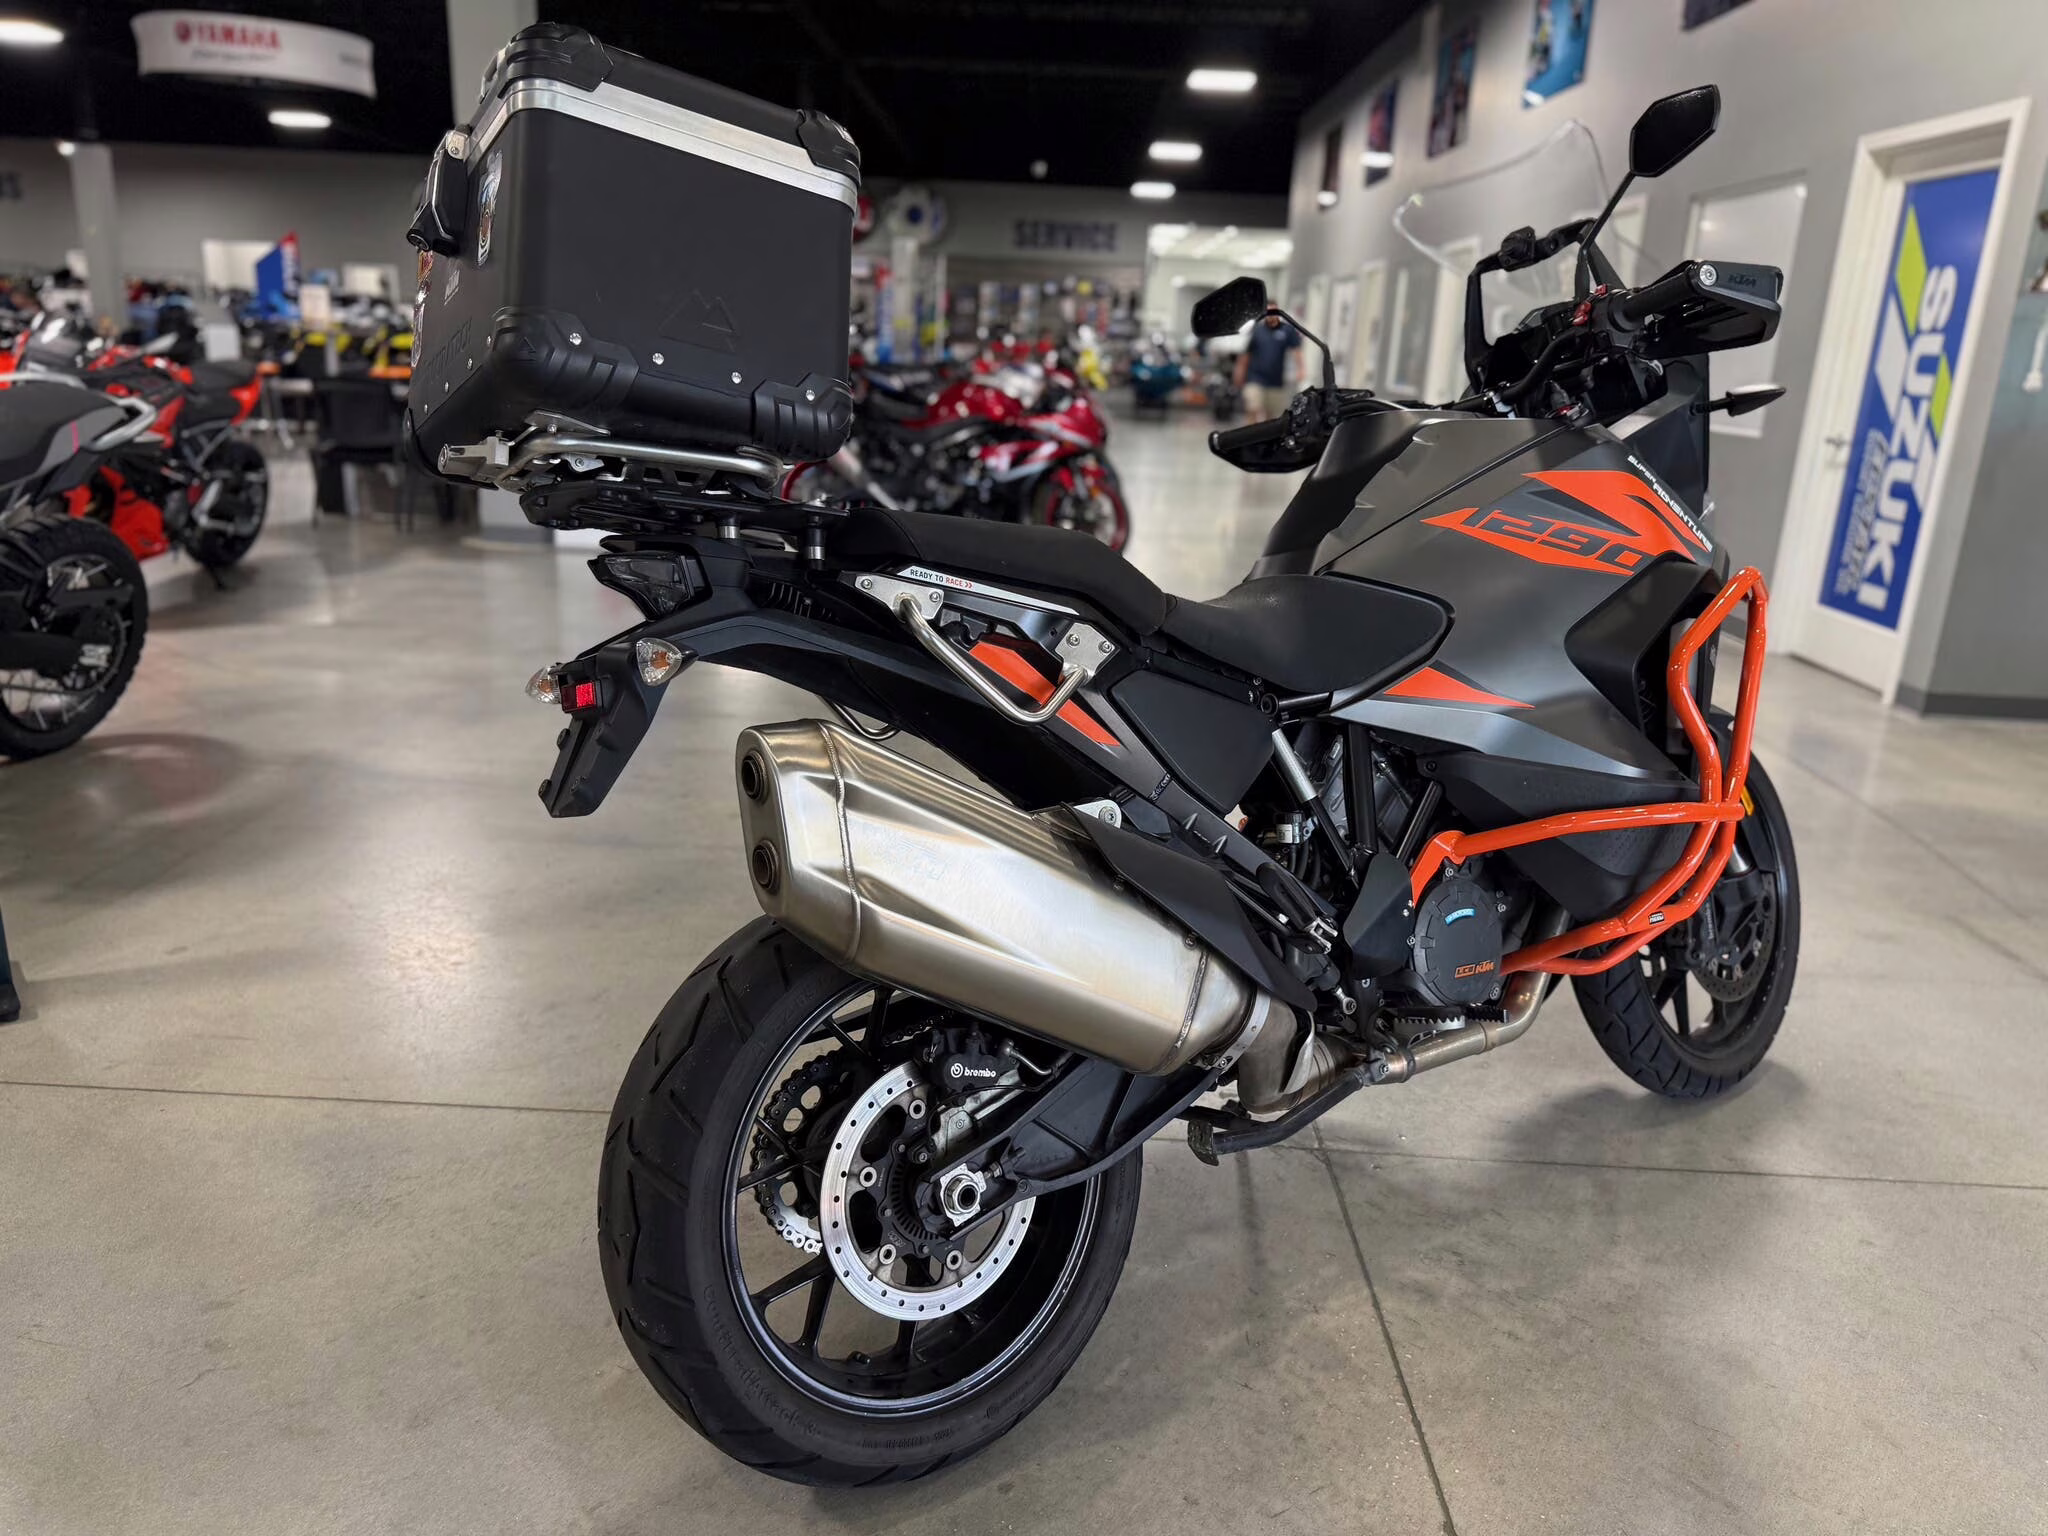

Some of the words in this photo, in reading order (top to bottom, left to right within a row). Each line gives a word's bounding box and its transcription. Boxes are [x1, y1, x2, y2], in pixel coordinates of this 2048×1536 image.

[196, 21, 281, 50] YAMAHA
[1013, 220, 1117, 252] SERVICE
[1856, 265, 1957, 610] SUZUKI
[1627, 455, 1656, 482] SUPER
[1653, 483, 1713, 552] ADVENTURE
[1460, 507, 1650, 571] 1290
[910, 568, 933, 580] READY
[935, 574, 944, 583] TO
[945, 576, 963, 587] RACE
[964, 1066, 996, 1078] brembo
